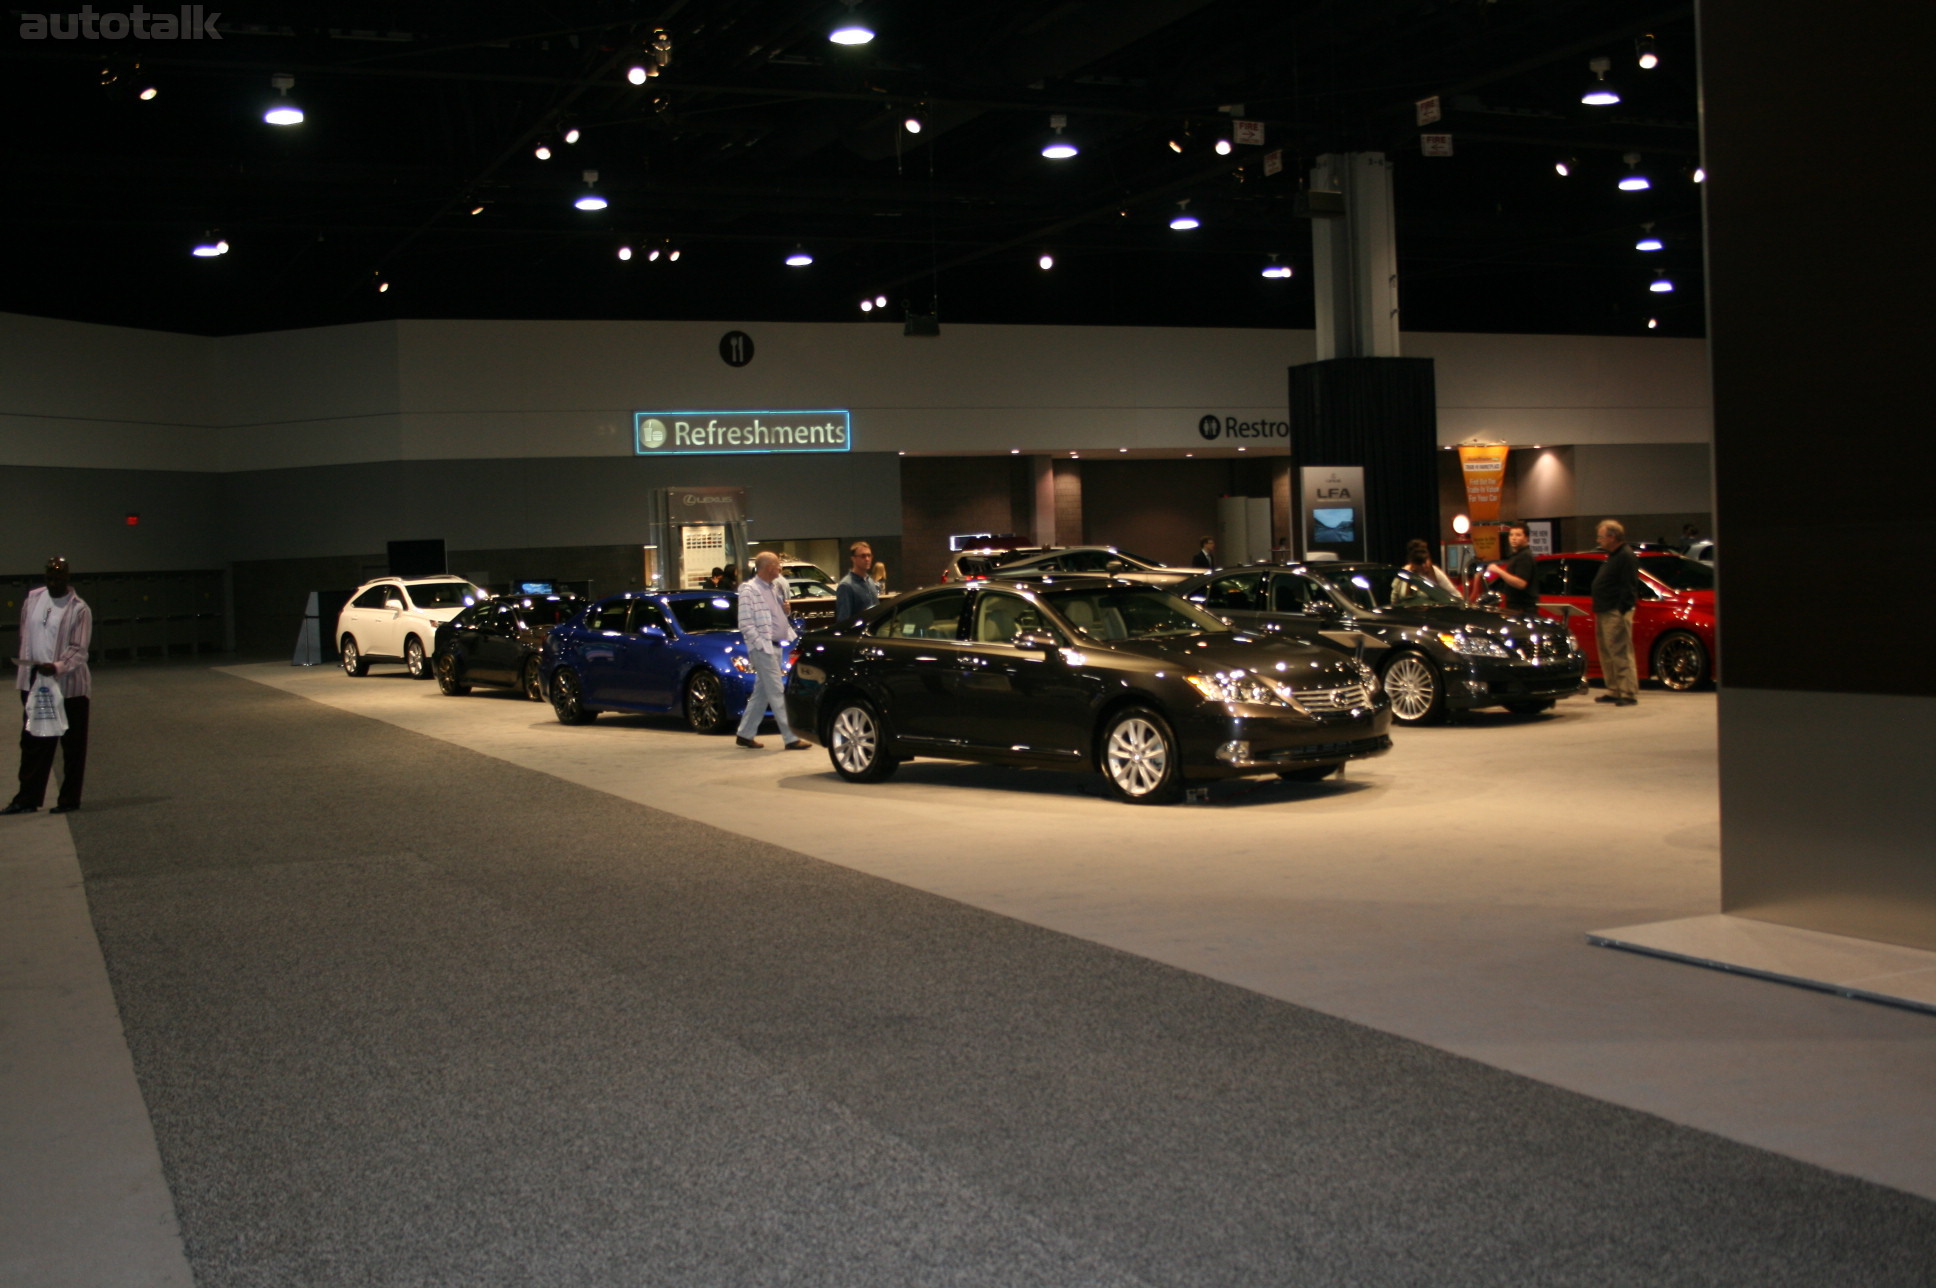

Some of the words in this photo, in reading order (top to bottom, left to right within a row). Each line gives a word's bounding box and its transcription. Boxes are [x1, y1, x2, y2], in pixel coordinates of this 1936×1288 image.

[1239, 121, 1259, 131] FIRE
[1426, 136, 1447, 144] FIRE
[1225, 416, 1290, 438] Restro
[674, 419, 847, 446] Refreshments
[1316, 487, 1352, 499] LFA
[696, 496, 733, 504] LEXUS
[802, 611, 835, 619] LEXUS
